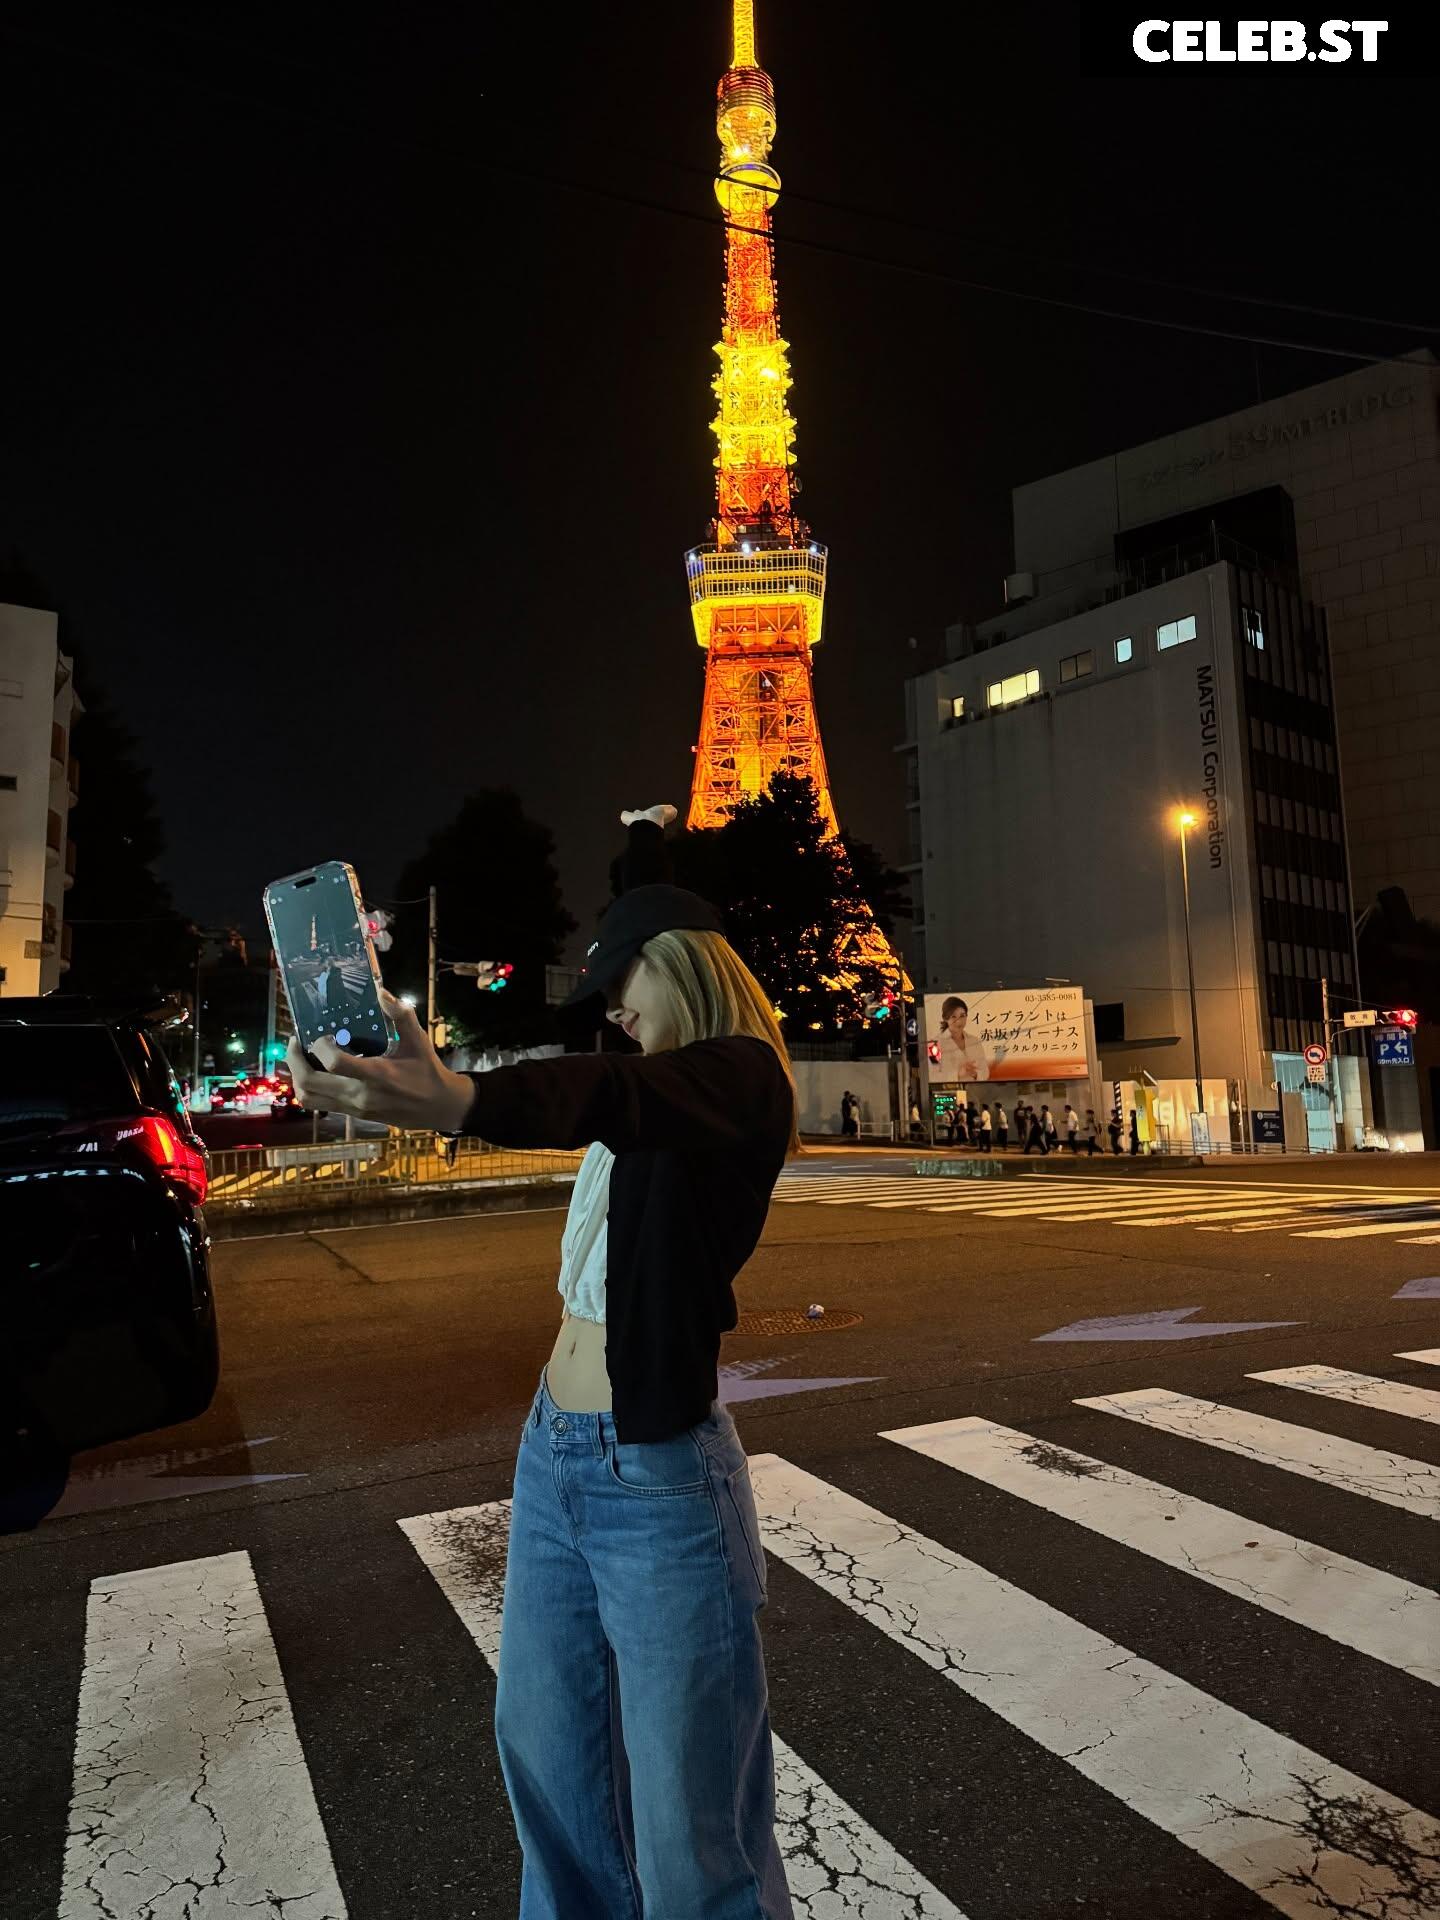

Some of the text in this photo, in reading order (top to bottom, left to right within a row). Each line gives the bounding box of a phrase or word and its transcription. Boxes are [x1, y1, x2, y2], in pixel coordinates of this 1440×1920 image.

[1197, 664, 1222, 869] MATSUI Corporation
[971, 1009, 1067, 1025] インプラントは
[980, 1026, 1079, 1042] 赤坂ヴィーナス
[992, 1042, 1079, 1053] デンタルクリニック
[1379, 1043, 1390, 1056] P
